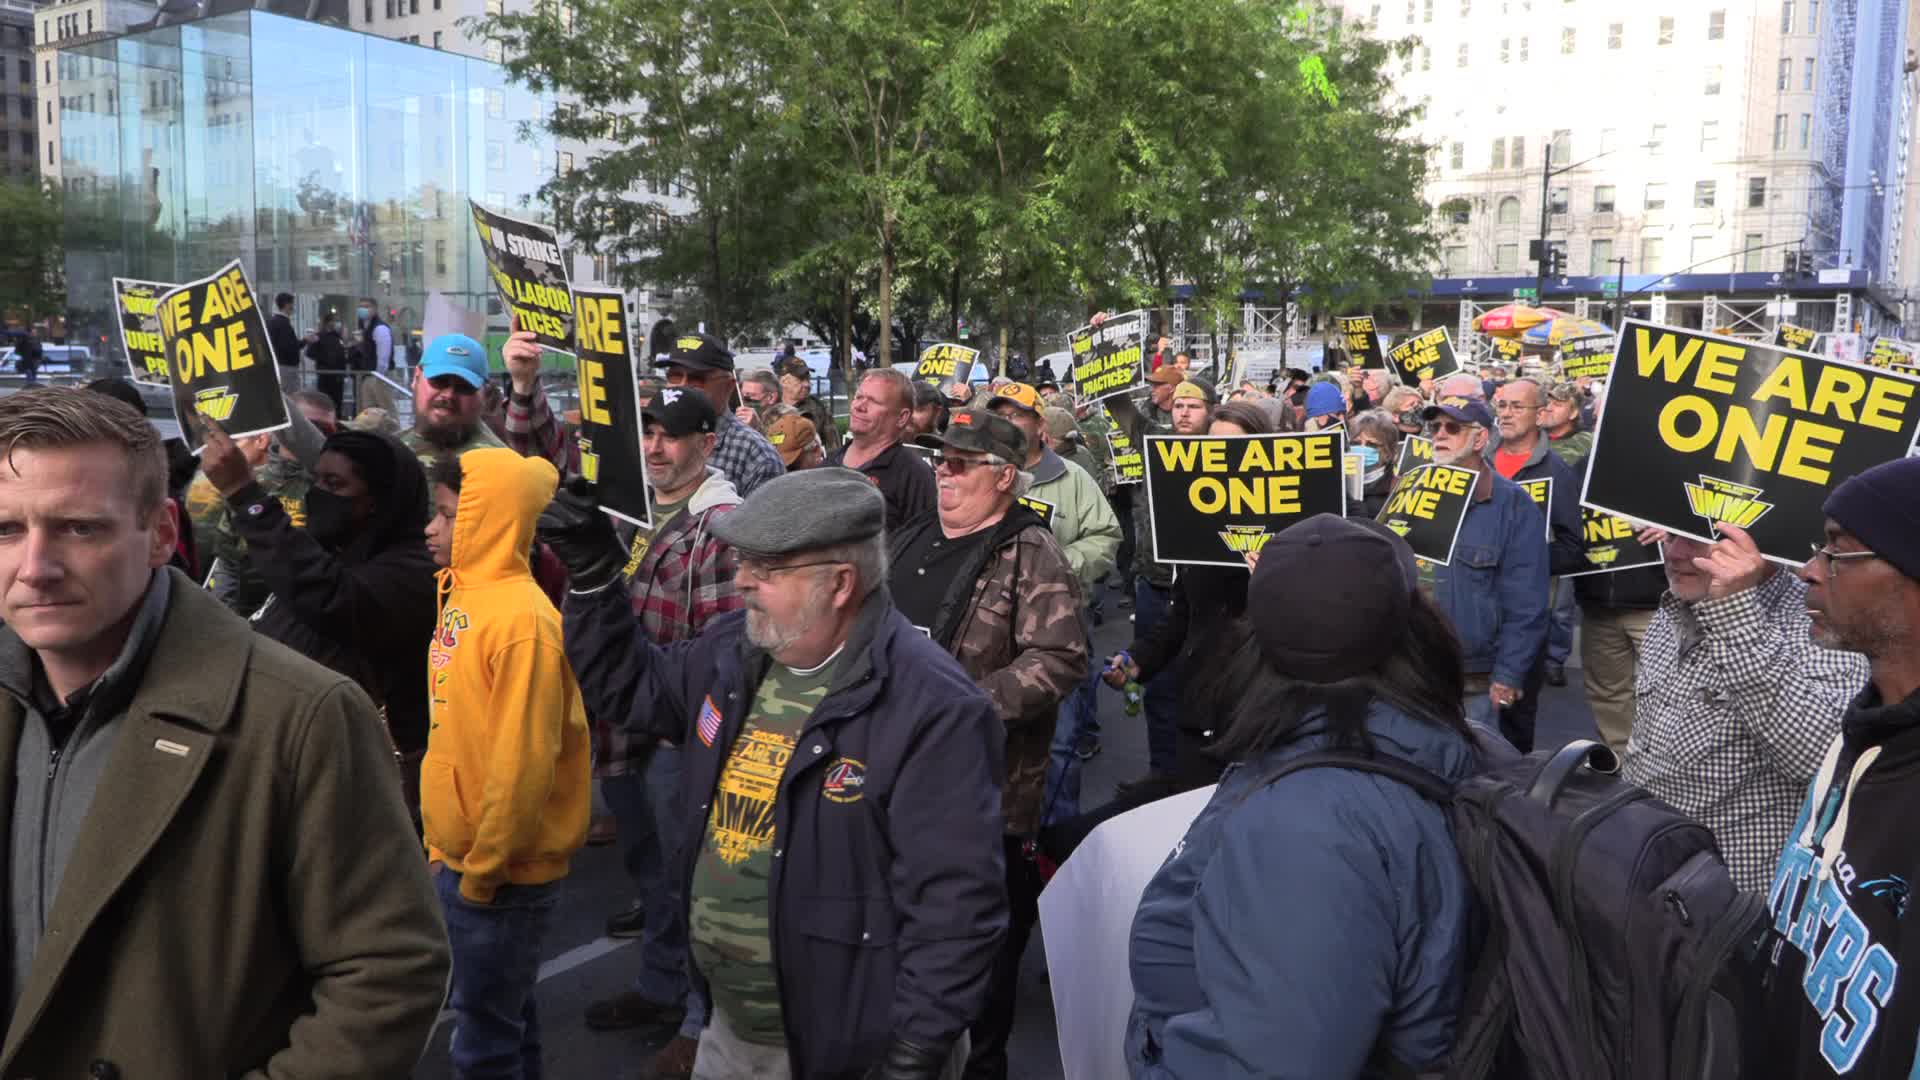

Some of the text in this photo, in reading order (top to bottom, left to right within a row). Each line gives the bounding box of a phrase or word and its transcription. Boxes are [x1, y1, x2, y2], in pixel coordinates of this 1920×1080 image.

[506, 233, 562, 266] STRIKE
[159, 268, 252, 341] WE ARE
[515, 279, 573, 314] LABOR
[512, 305, 566, 340] TICES
[1103, 320, 1140, 341] STRIKE
[1349, 319, 1373, 332] ARE
[176, 320, 254, 384] ONE
[937, 345, 975, 364] ARE
[1104, 346, 1140, 370] LABOR
[1392, 329, 1446, 362] WE ARE
[1404, 346, 1441, 372] ONE
[919, 359, 957, 376] ONE
[1083, 368, 1133, 397] PRACTICES
[1634, 327, 1915, 433] WE ARE
[1155, 440, 1228, 472] WE
[1238, 436, 1333, 472] ARE
[1411, 438, 1433, 460] W
[1658, 395, 1845, 486] ONE
[1188, 476, 1302, 515] ONE
[1413, 466, 1471, 496] ARE
[1387, 489, 1440, 520] ONE
